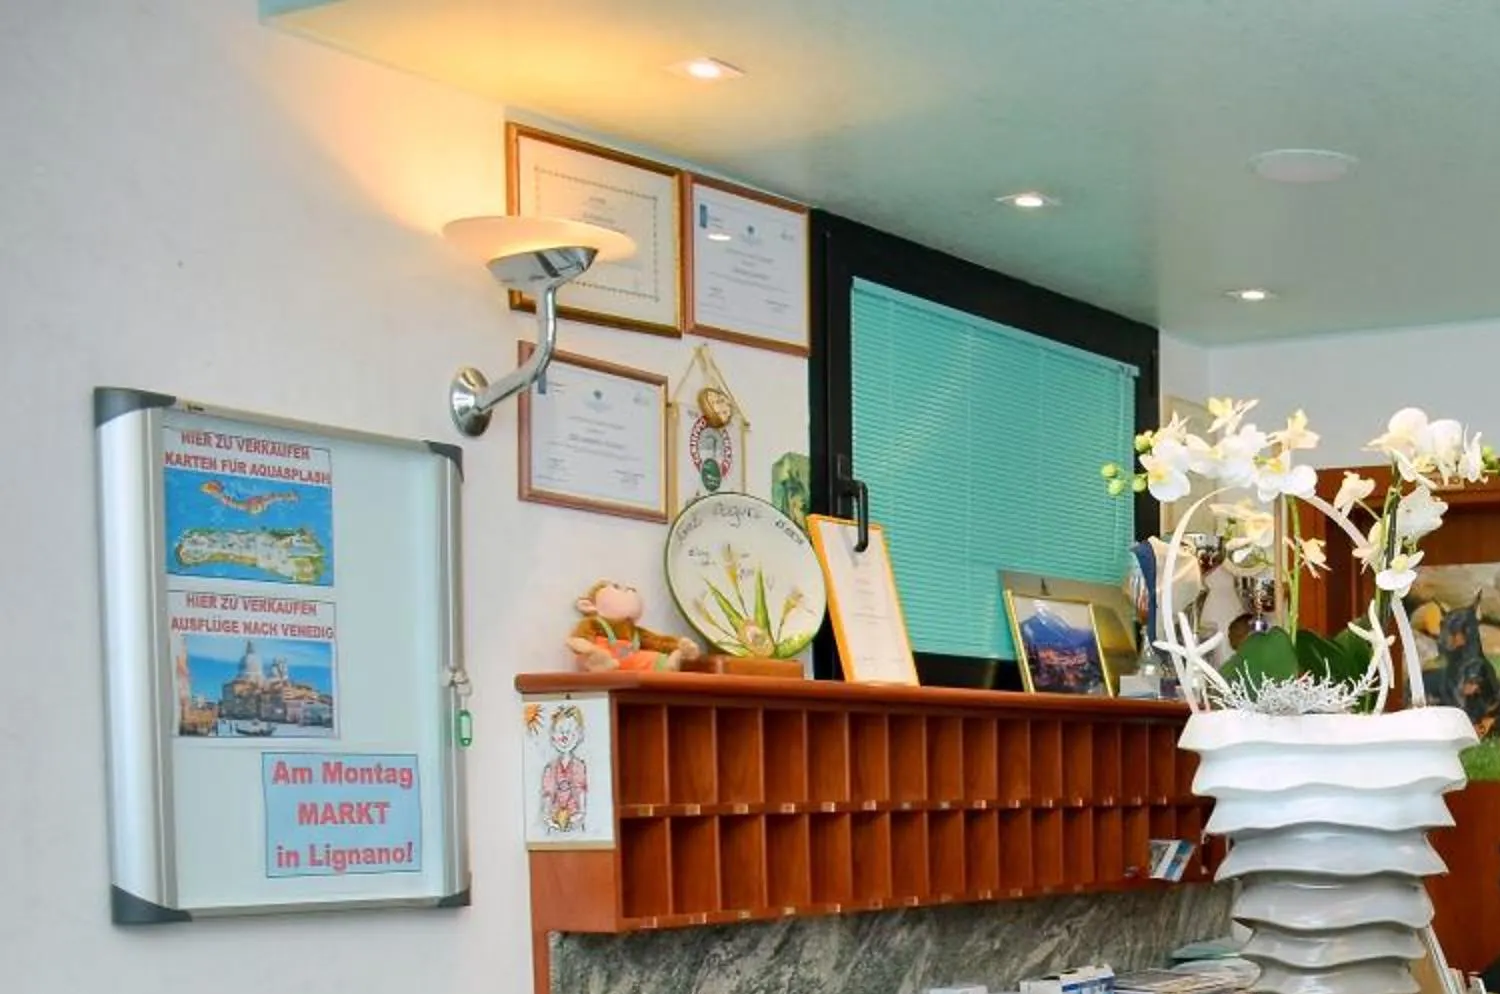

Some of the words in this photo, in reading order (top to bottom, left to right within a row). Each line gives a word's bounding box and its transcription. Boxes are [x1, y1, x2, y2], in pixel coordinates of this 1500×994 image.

[181, 431, 213, 447] HIER
[215, 433, 233, 450] ZU
[237, 436, 310, 460] VERKAUFEN
[165, 451, 217, 470] KARTEN
[249, 461, 332, 484] AQUASPLASH
[186, 594, 218, 609] HIER
[221, 597, 238, 611] ZU
[242, 597, 317, 616] VERKAUFEN
[171, 615, 240, 634] AUSFLÜGE
[243, 621, 278, 636] NACH
[281, 623, 334, 640] VENEDIG
[273, 760, 313, 785] Am
[321, 761, 413, 790] Montag
[297, 801, 391, 827] MARKT
[277, 845, 300, 868] in
[309, 841, 414, 873] Lignano!
